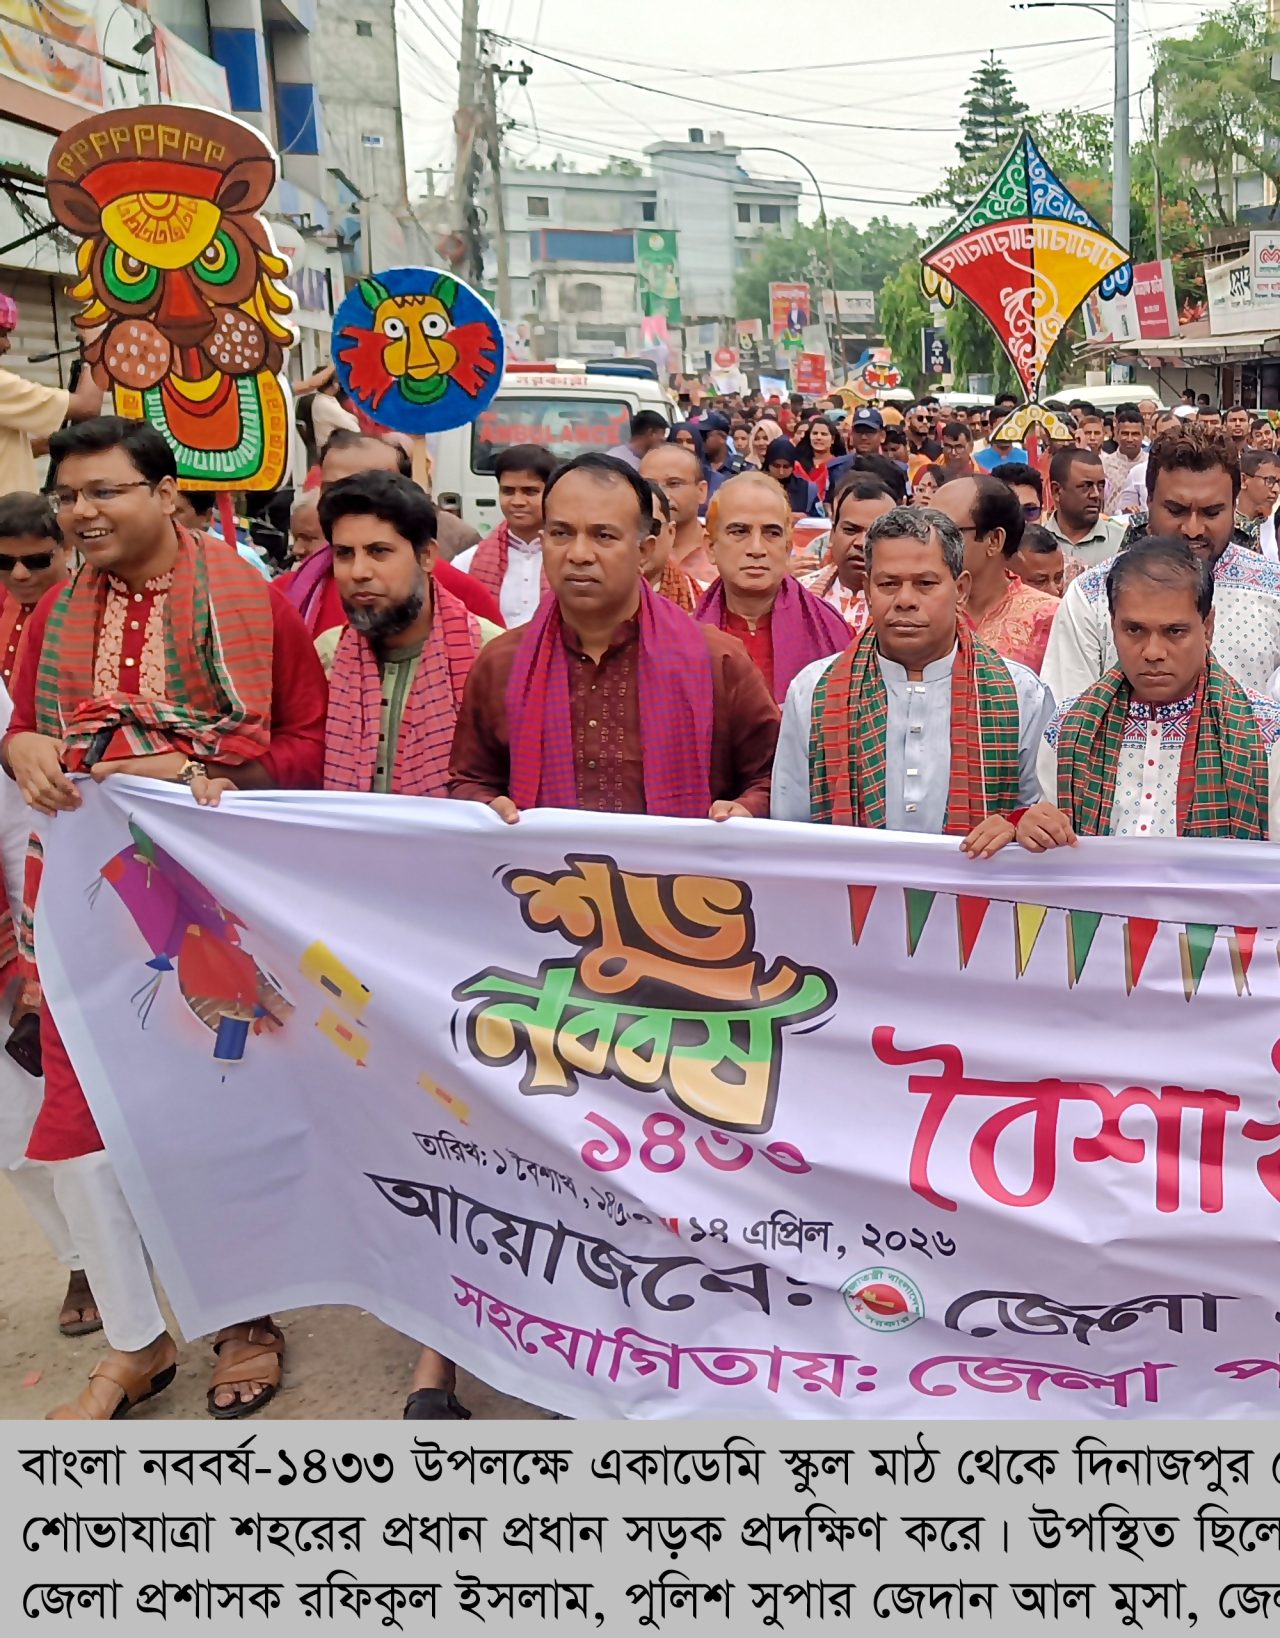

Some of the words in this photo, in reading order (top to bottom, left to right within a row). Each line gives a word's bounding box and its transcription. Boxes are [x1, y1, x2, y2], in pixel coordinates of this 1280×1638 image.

[931, 340, 944, 364] ATM
[480, 424, 620, 444] AMBULANCE
[504, 855, 757, 1003] শুভ
[453, 957, 837, 1133] নববর্ষ
[364, 1171, 813, 1316] আয়োজনে:
[944, 1287, 1243, 1346] জেলা
[412, 1131, 488, 1168] তারিখ:
[743, 1210, 846, 1261] এপ্রিল,
[864, 1223, 957, 1260] ২০২৬
[450, 1274, 880, 1397] সহযোগিতায়:
[909, 1354, 1178, 1408] জেলা
